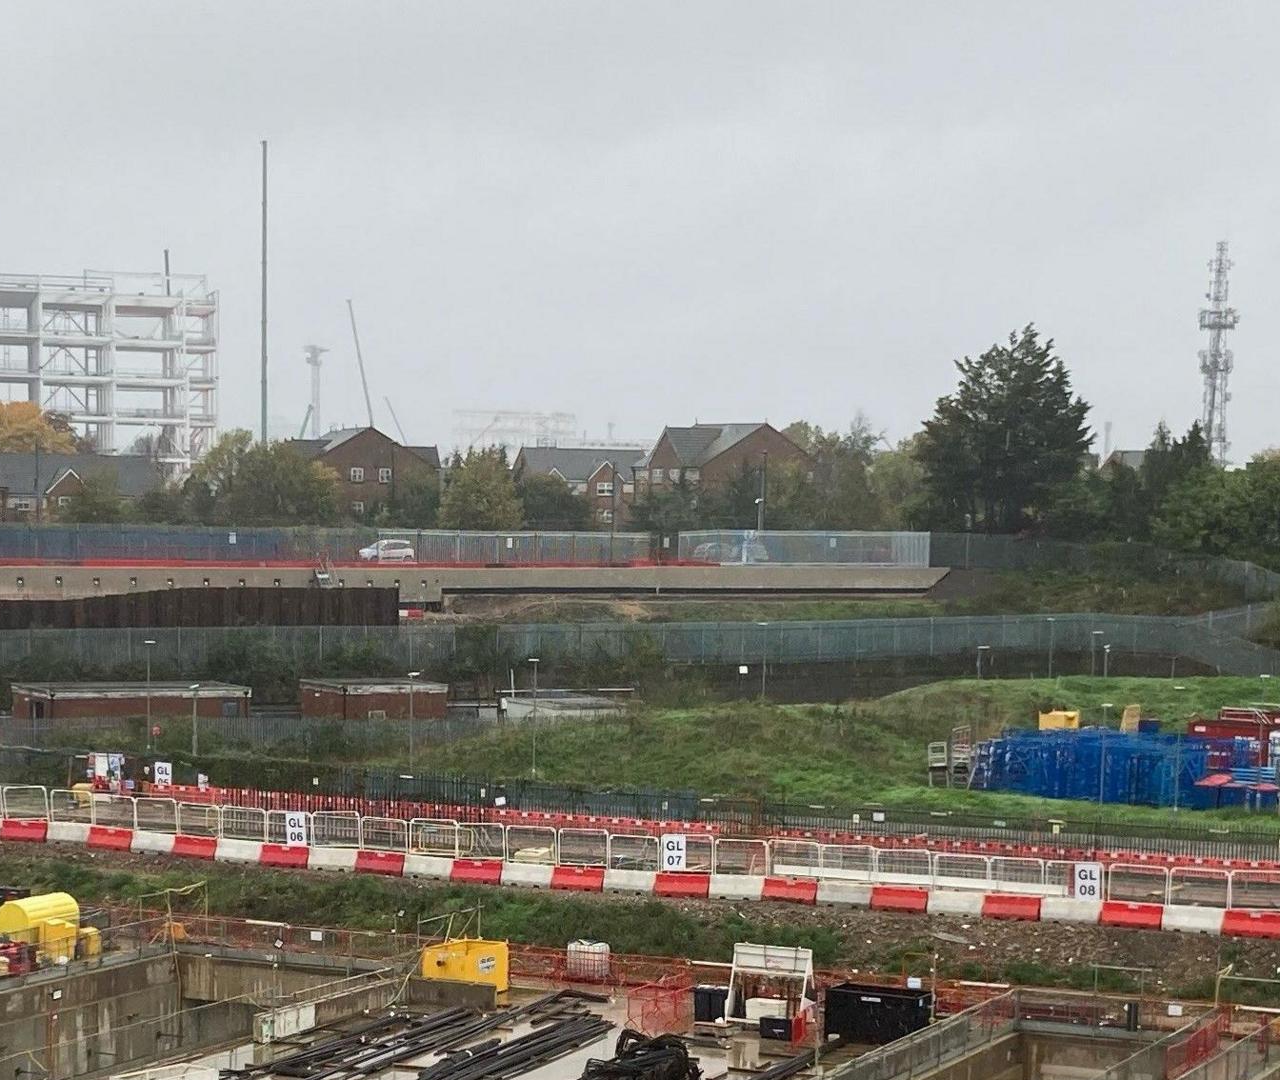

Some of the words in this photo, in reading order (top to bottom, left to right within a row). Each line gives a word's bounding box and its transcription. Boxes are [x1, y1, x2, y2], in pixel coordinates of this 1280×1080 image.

[157, 766, 170, 776] GL
[288, 817, 303, 828] GL
[290, 831, 304, 842] 06
[666, 840, 683, 851] GL
[667, 855, 682, 866] 07
[1078, 869, 1097, 881] GL
[1079, 884, 1096, 896] 08
